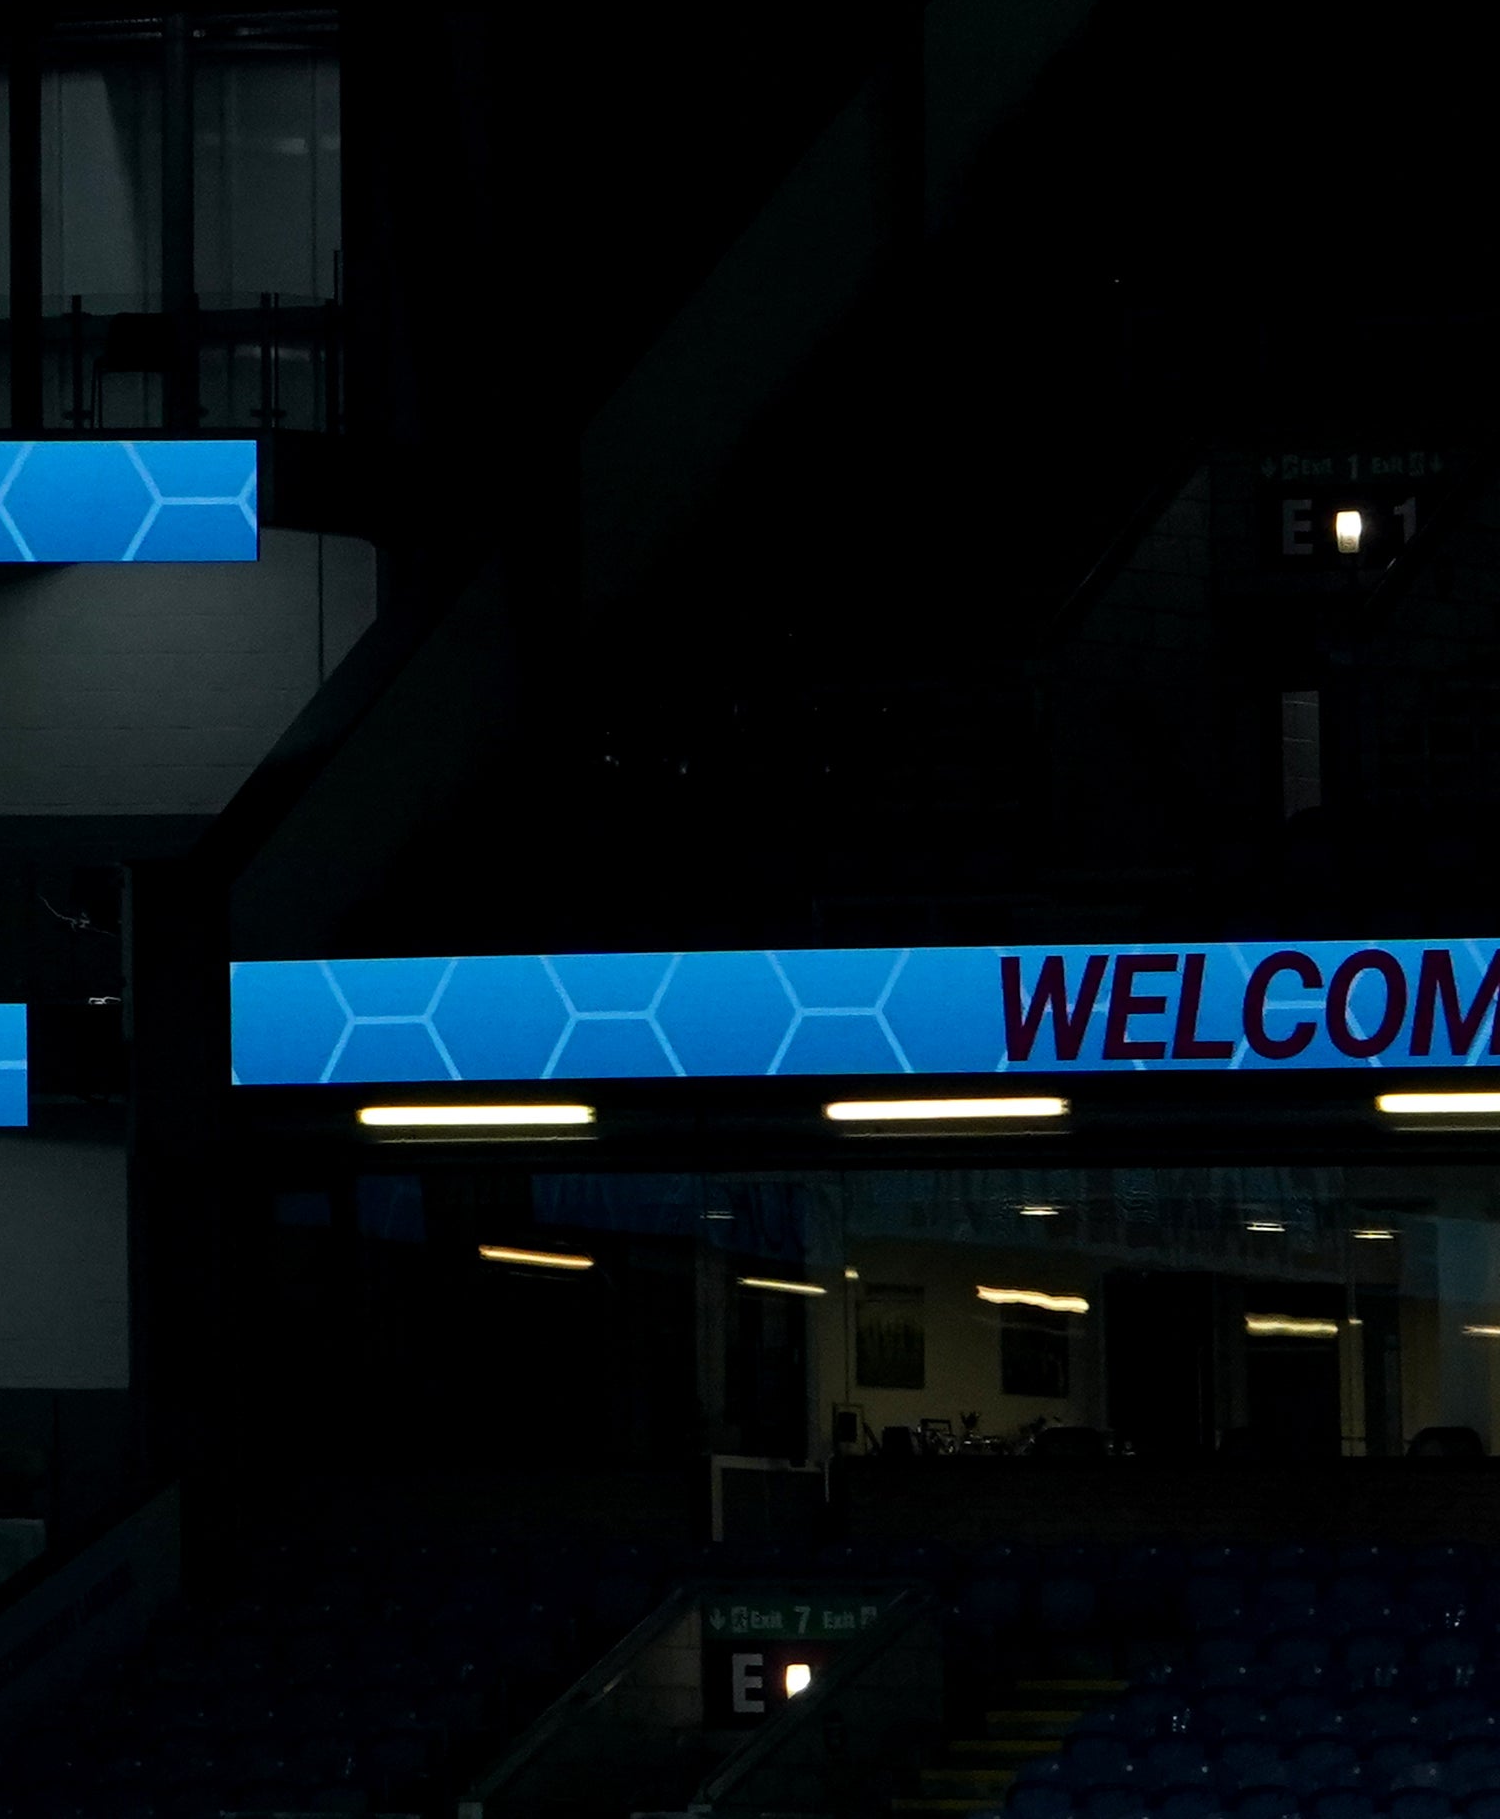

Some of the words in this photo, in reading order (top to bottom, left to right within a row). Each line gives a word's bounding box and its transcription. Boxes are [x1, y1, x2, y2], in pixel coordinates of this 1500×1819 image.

[1280, 498, 1314, 556] E
[1001, 948, 1500, 1062] WELCOM
[750, 1609, 783, 1630] Exit
[792, 1605, 812, 1635] 7
[822, 1610, 856, 1630] Exit
[731, 1652, 766, 1714] E
